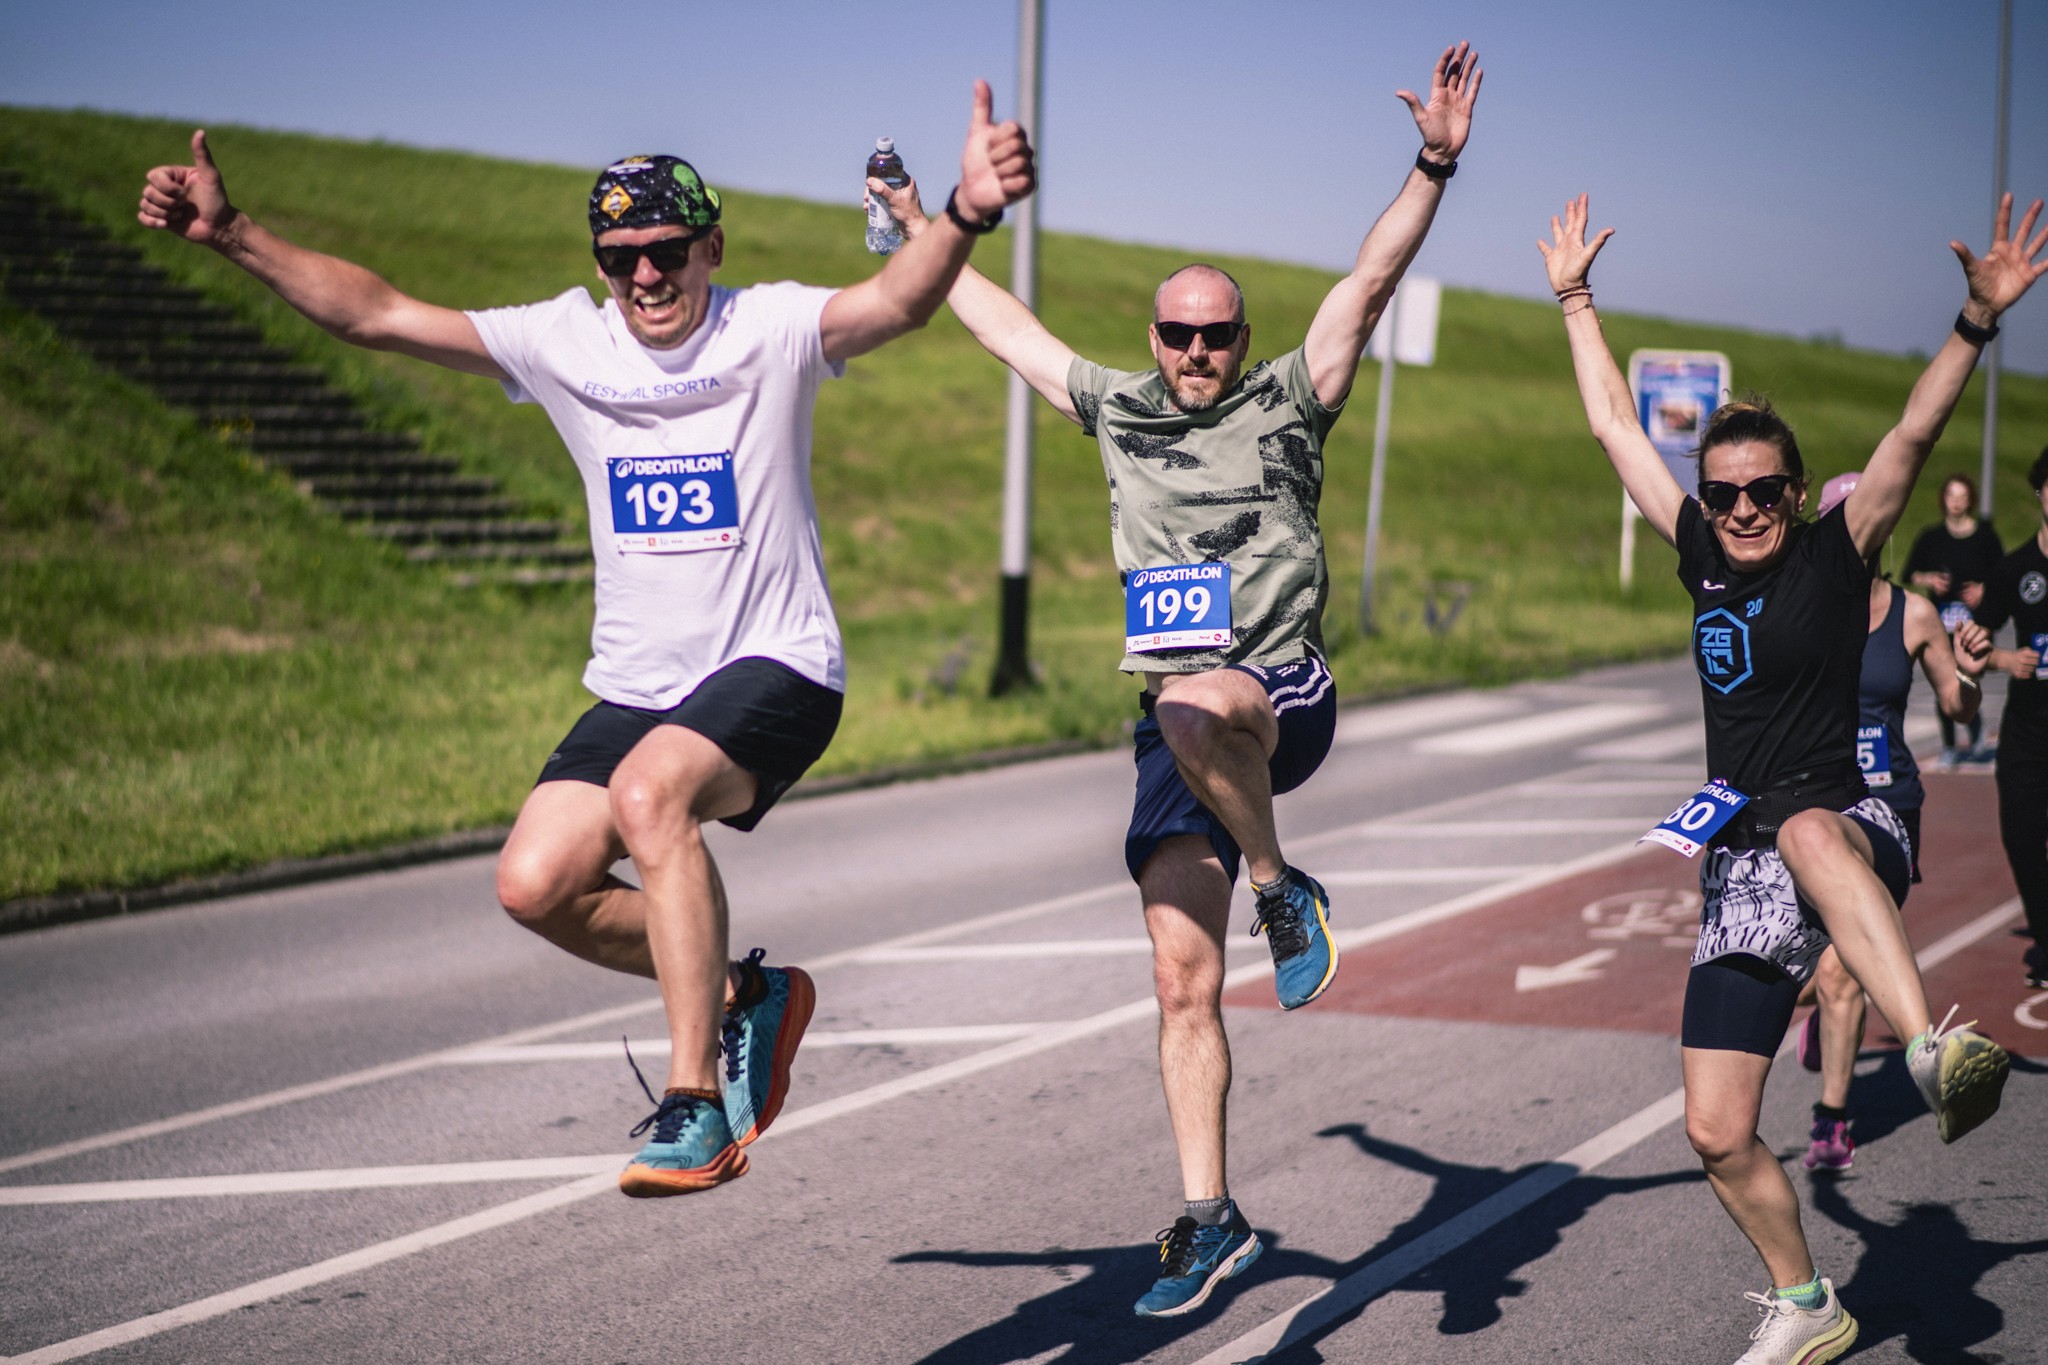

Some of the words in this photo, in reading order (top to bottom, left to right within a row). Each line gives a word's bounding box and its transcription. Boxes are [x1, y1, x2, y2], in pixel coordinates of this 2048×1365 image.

[653, 377, 721, 398] SPORTA
[634, 456, 723, 475] DECATHLON
[625, 479, 714, 526] 193
[1149, 567, 1222, 584] DECATHLON
[1140, 586, 1211, 627] 199
[1746, 598, 1763, 618] 20
[1700, 627, 1733, 647] ZG
